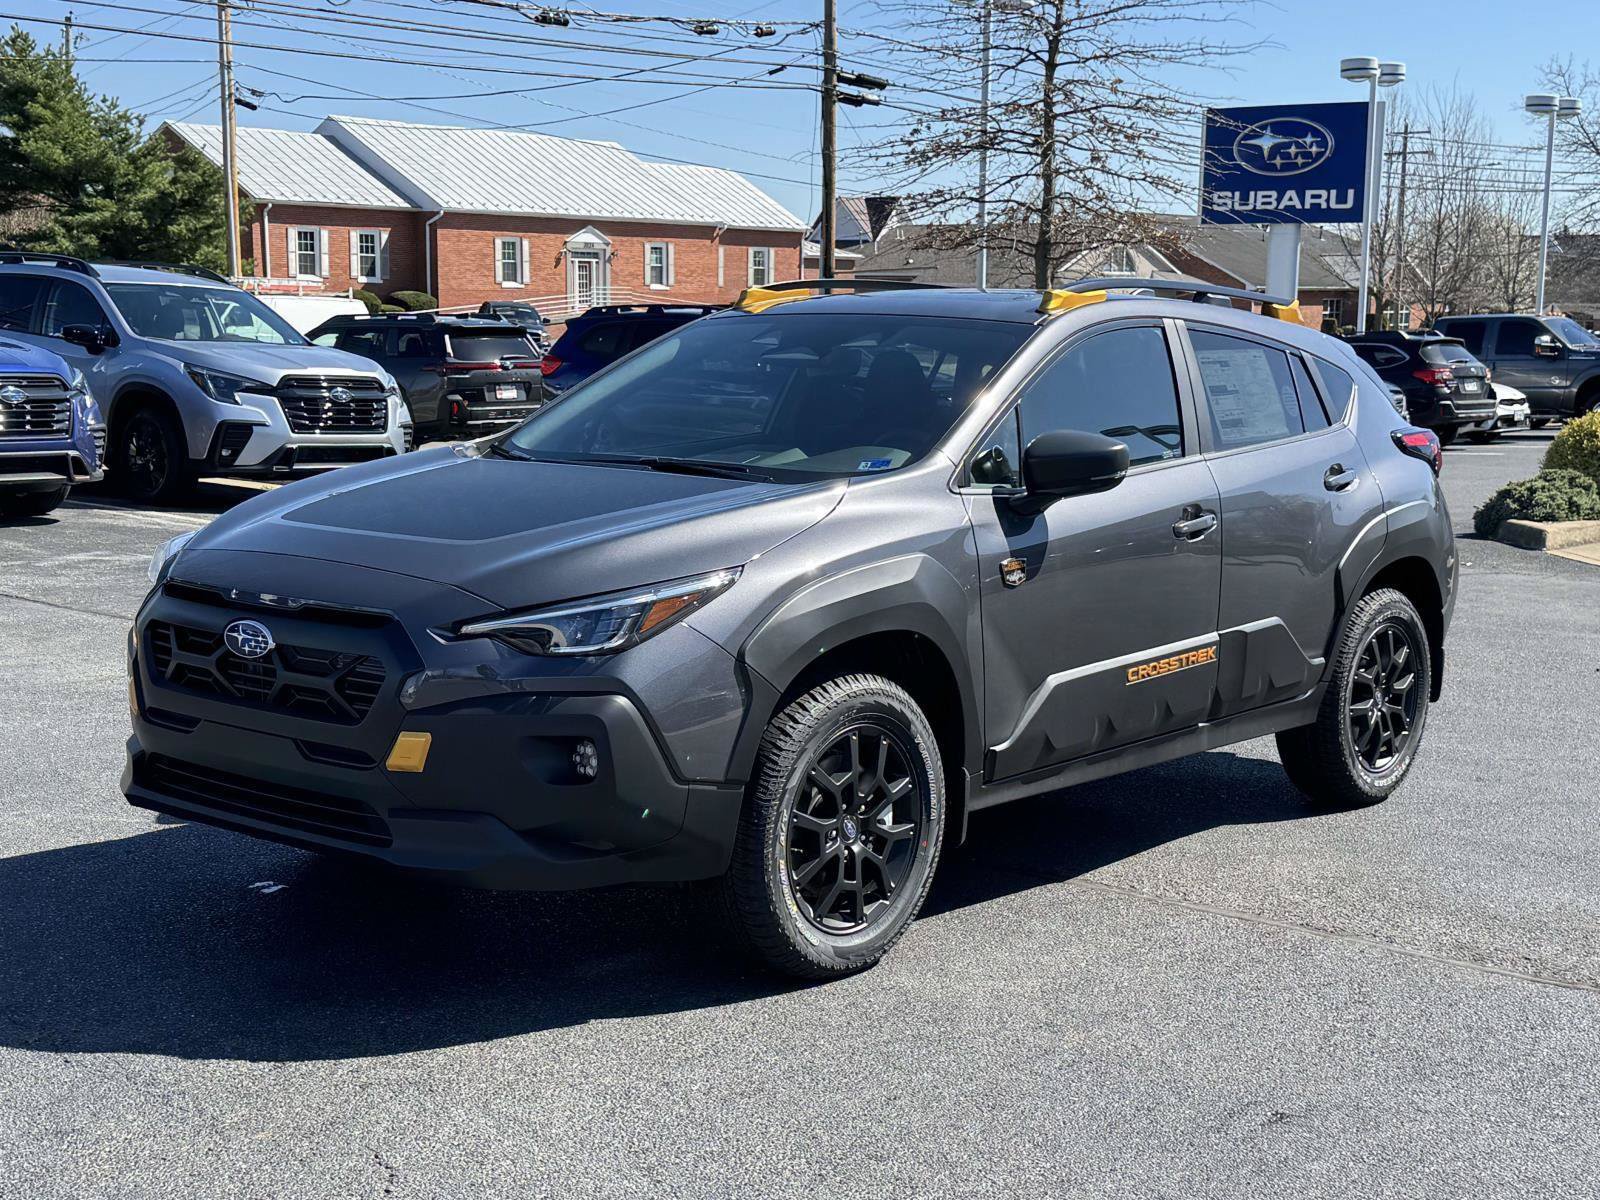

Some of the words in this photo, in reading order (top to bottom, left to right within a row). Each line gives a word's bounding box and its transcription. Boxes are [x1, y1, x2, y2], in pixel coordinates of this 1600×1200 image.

[1212, 189, 1354, 212] SUBARU
[1127, 646, 1217, 682] CROSSTREK
[914, 735, 936, 821] YOKOHAMA
